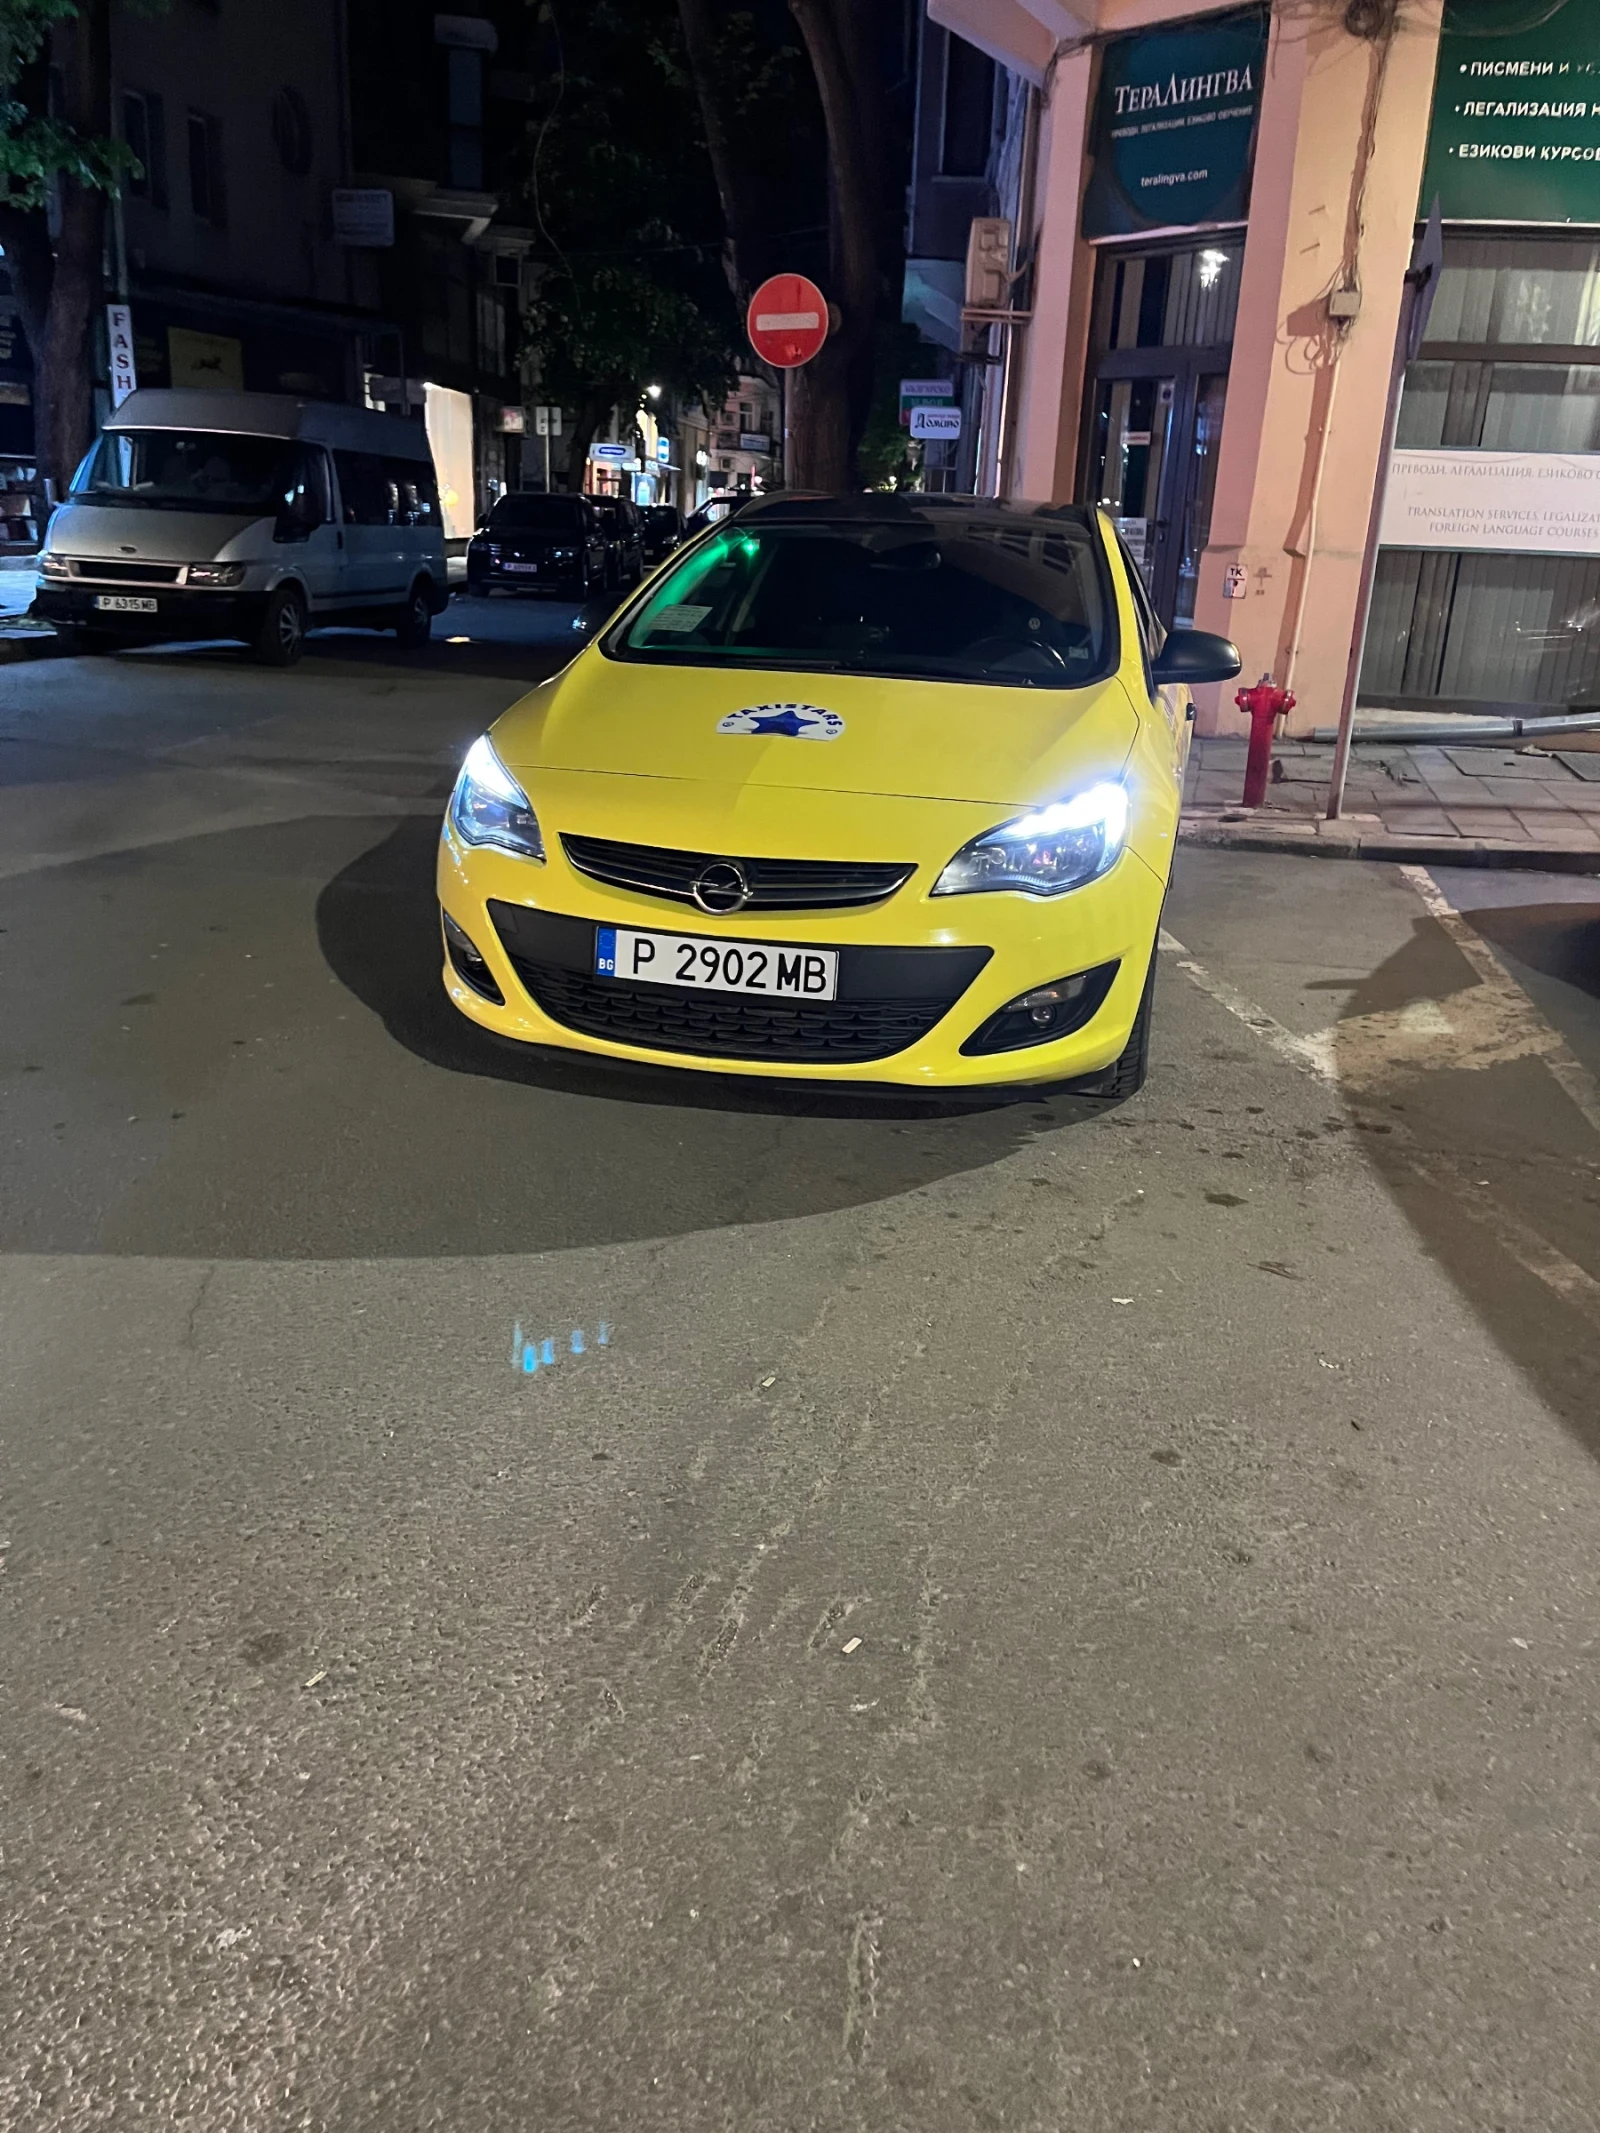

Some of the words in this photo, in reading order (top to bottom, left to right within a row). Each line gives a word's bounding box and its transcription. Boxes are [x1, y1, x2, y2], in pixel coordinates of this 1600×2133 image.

[1470, 61, 1553, 76] ПИСМЕНИ
[1559, 61, 1570, 75] И
[1463, 101, 1587, 118] ЛЕГАЛИЗАЦИЯ
[1458, 144, 1536, 159] ЕЗИКОВИ
[1140, 169, 1208, 187] teralingva.com
[1537, 468, 1593, 480] ЕЗИКОВО
[1408, 506, 1484, 519] TRANSLATION
[1429, 522, 1479, 534] FOREIGN
[1482, 524, 1543, 536] LANGUAGE
[1547, 526, 1599, 539] COURSES
[599, 957, 614, 970] BG
[633, 938, 655, 974] P
[675, 944, 768, 989] 2902
[776, 953, 827, 993] MB
